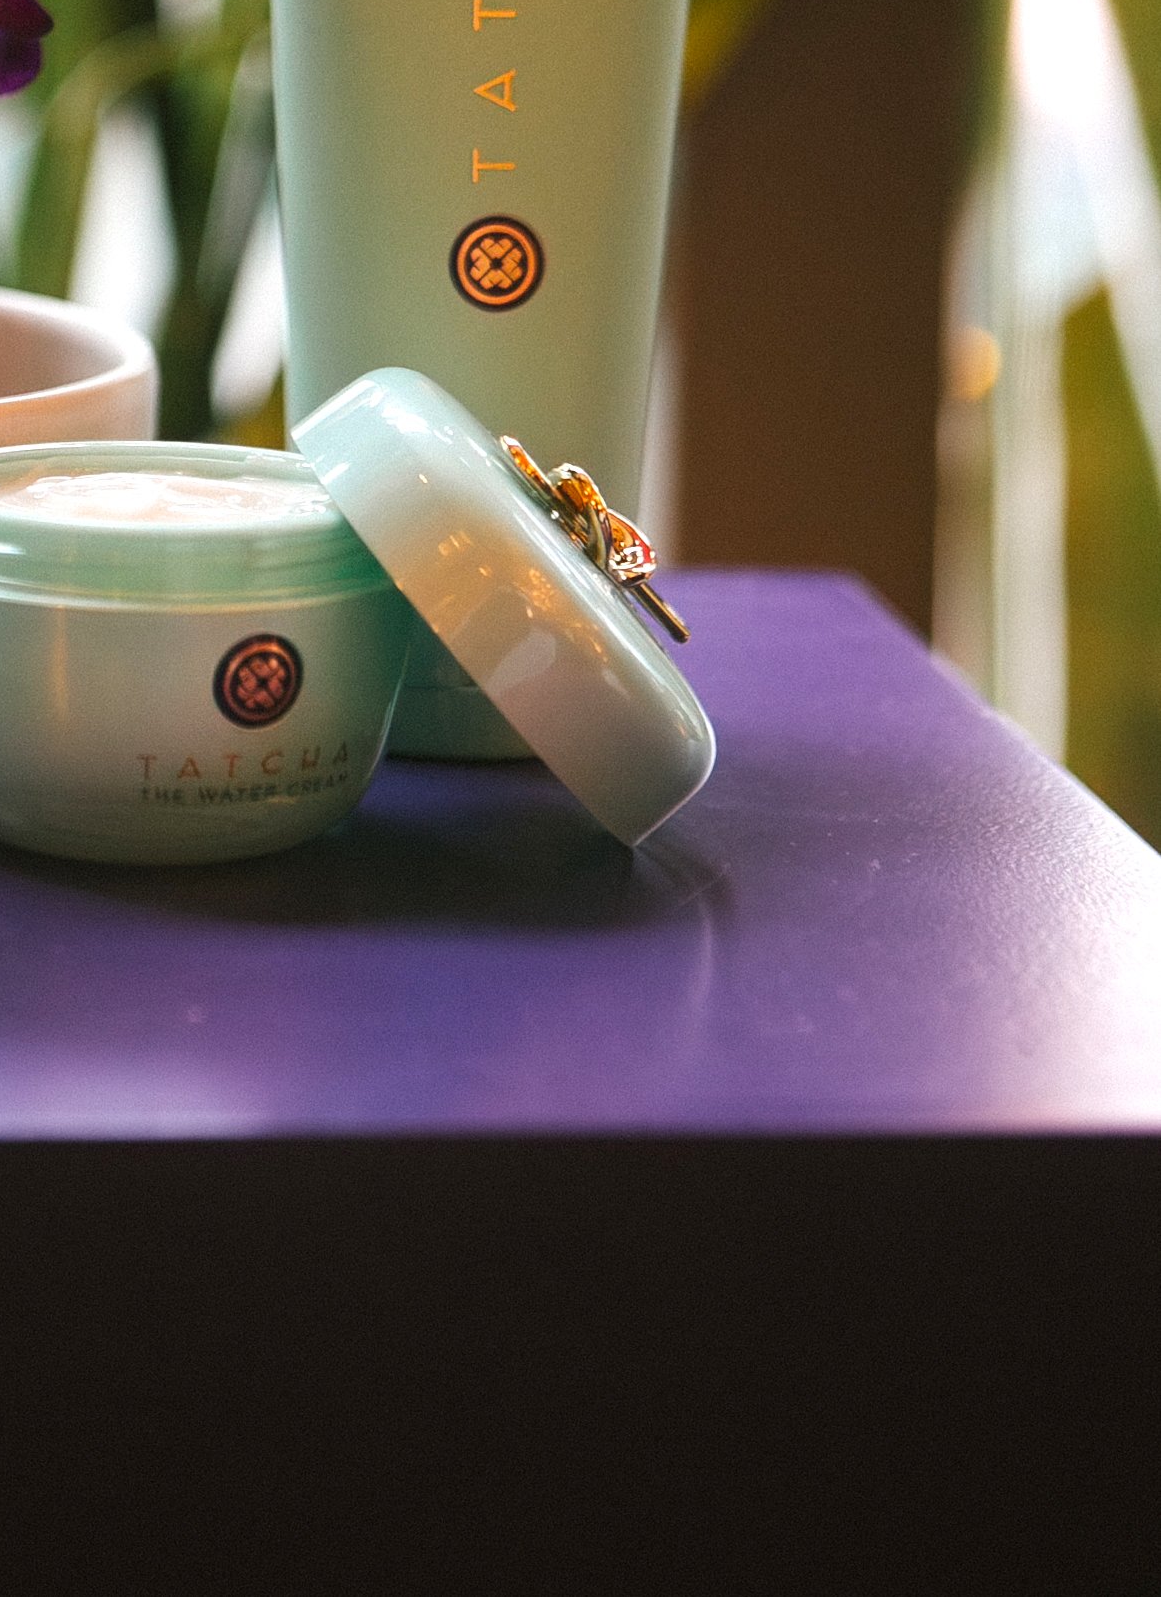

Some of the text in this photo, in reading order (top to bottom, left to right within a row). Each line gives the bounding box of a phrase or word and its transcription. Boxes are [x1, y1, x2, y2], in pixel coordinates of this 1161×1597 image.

[136, 741, 349, 779] TATCHA
[140, 786, 185, 803] THE
[196, 783, 278, 804] WATER
